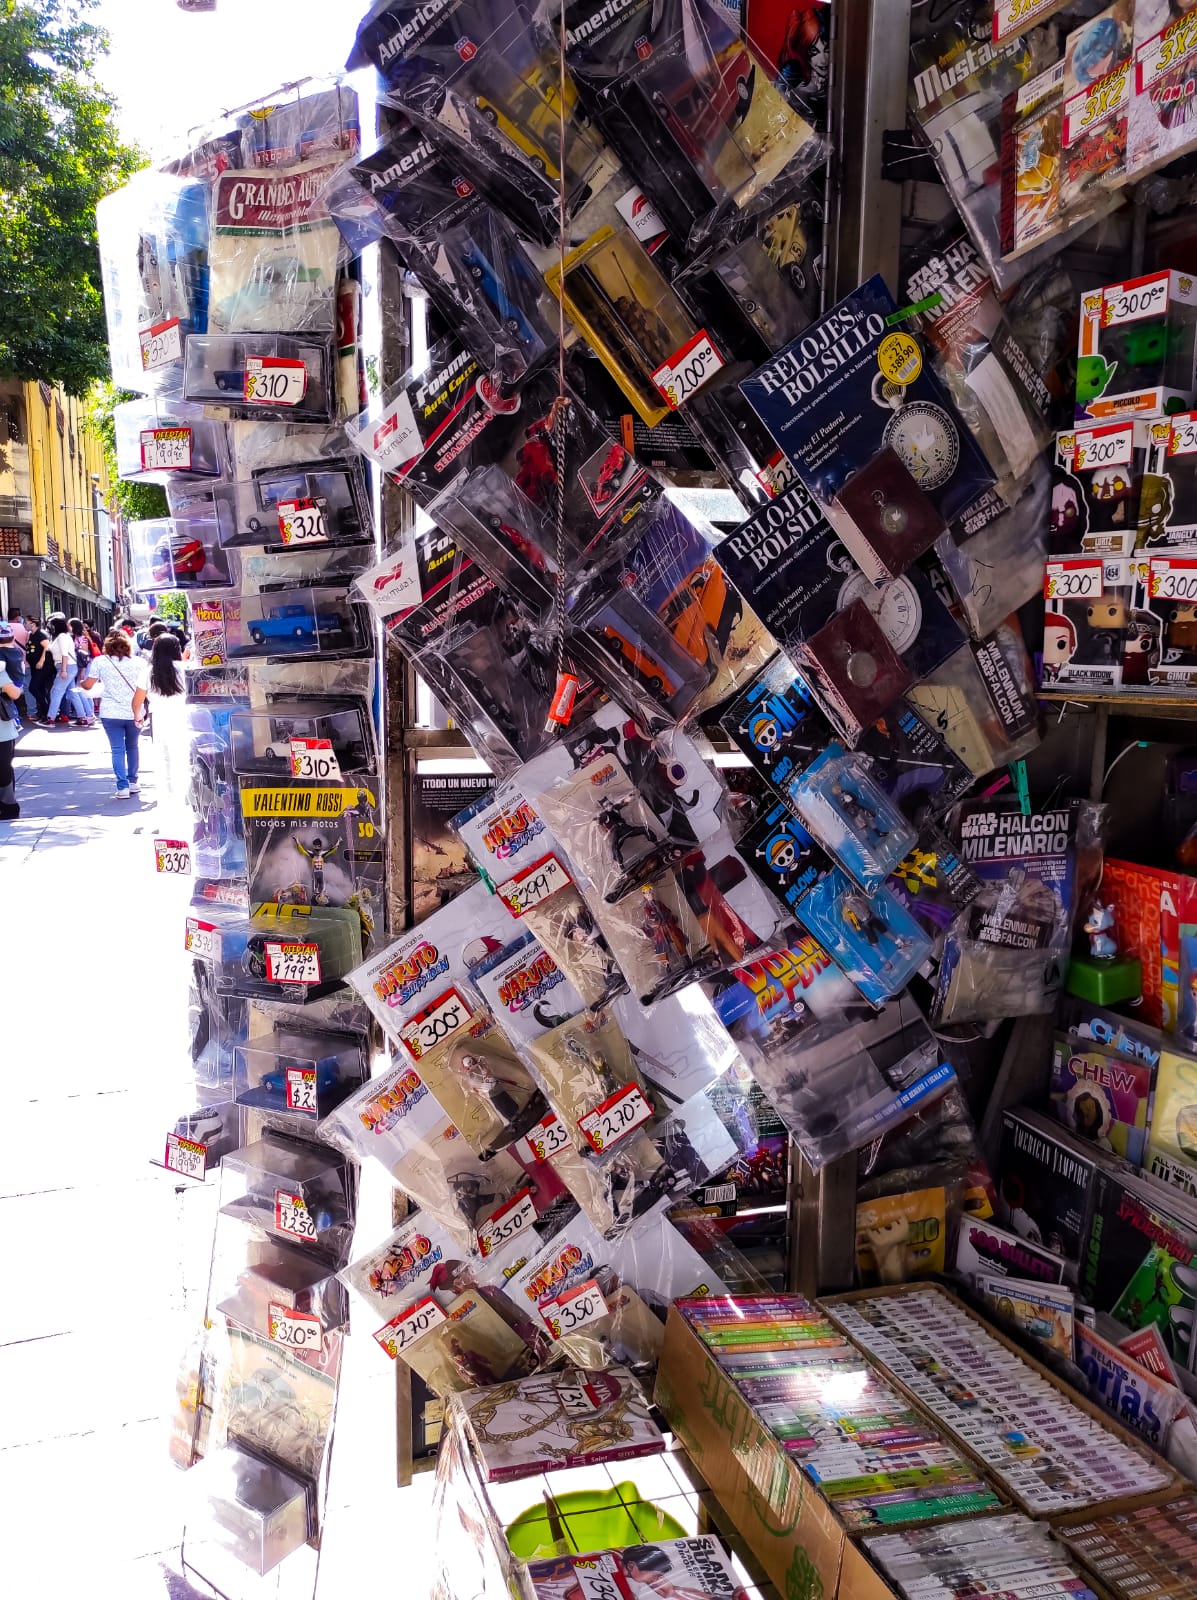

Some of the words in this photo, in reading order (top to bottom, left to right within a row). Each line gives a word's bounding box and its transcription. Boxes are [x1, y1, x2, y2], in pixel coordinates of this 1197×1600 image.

[229, 175, 296, 220] GRANDES
[758, 306, 855, 396] RELOJES
[780, 313, 885, 407] BOLSILLO
[986, 641, 1025, 719] MILLENNIUM
[1067, 669, 1090, 678] BLACK
[1090, 670, 1112, 679] WIDOW
[989, 674, 1015, 724] FALCON
[448, 778, 459, 788] UN
[460, 778, 486, 788] NUEVO
[771, 756, 793, 785] SABO
[253, 792, 311, 812] VALENTINO
[316, 794, 343, 812] ROSSI
[255, 819, 286, 829] todos
[290, 820, 308, 829] mis
[311, 820, 339, 829] motos
[1000, 814, 1069, 835] HALCON
[962, 832, 1068, 858] MILENARIO
[784, 866, 818, 904] ARLONG
[1000, 931, 1037, 950] FALCON
[372, 944, 439, 1001] NARUTO
[1067, 1055, 1136, 1094] CHEW
[1014, 1124, 1051, 1166] AMERICAN
[1052, 1146, 1089, 1189] VAMPIRE
[1153, 1155, 1193, 1182] ALL-NEW
[523, 1245, 583, 1303] NARUTO
[685, 1536, 722, 1594] DUNK
[696, 1535, 734, 1595] SLAM
